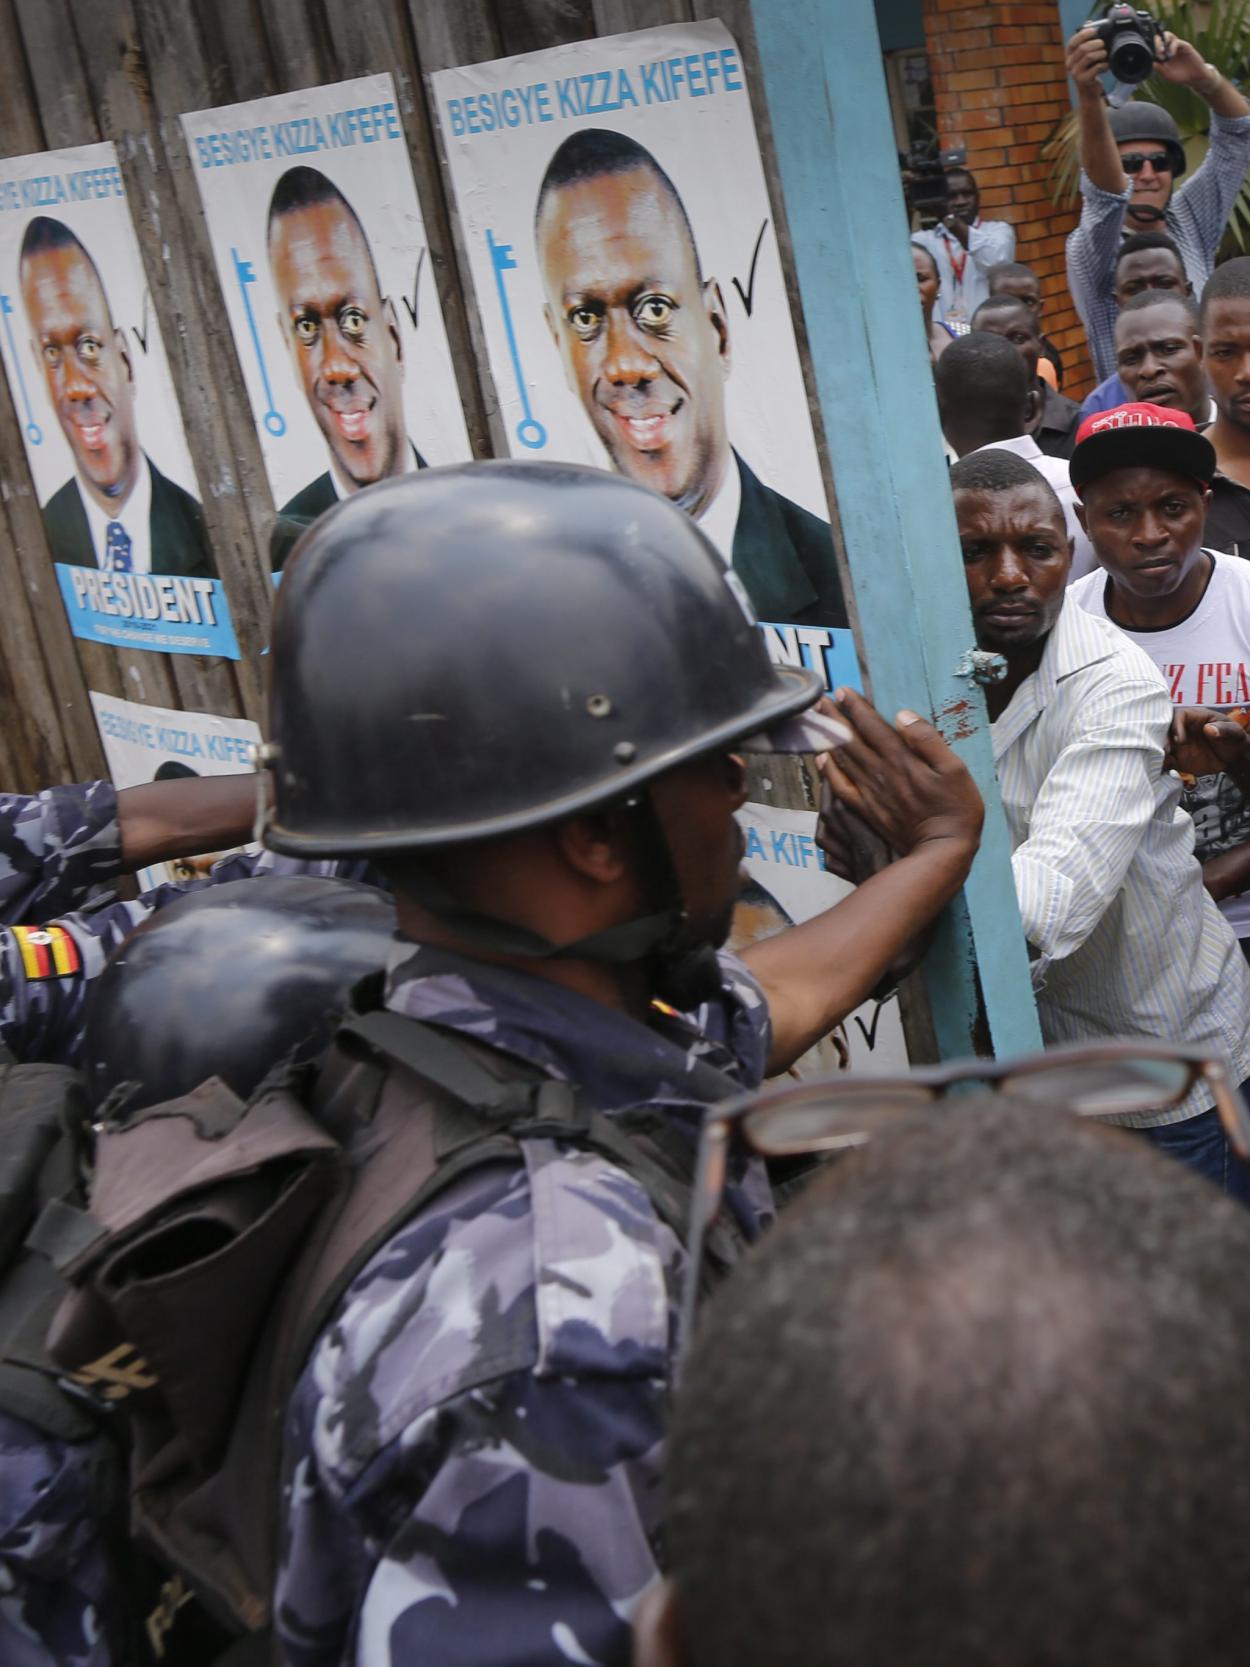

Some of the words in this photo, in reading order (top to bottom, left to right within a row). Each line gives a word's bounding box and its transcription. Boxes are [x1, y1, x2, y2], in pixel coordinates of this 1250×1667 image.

[448, 83, 552, 136] BESIGYE
[555, 69, 639, 118] KIZZA
[640, 48, 743, 104] KIFEFE
[195, 126, 272, 168] BESIGYE
[271, 117, 329, 157] KIZZA
[326, 102, 401, 149] KIFEFE
[69, 567, 217, 626] PRESIDENT
